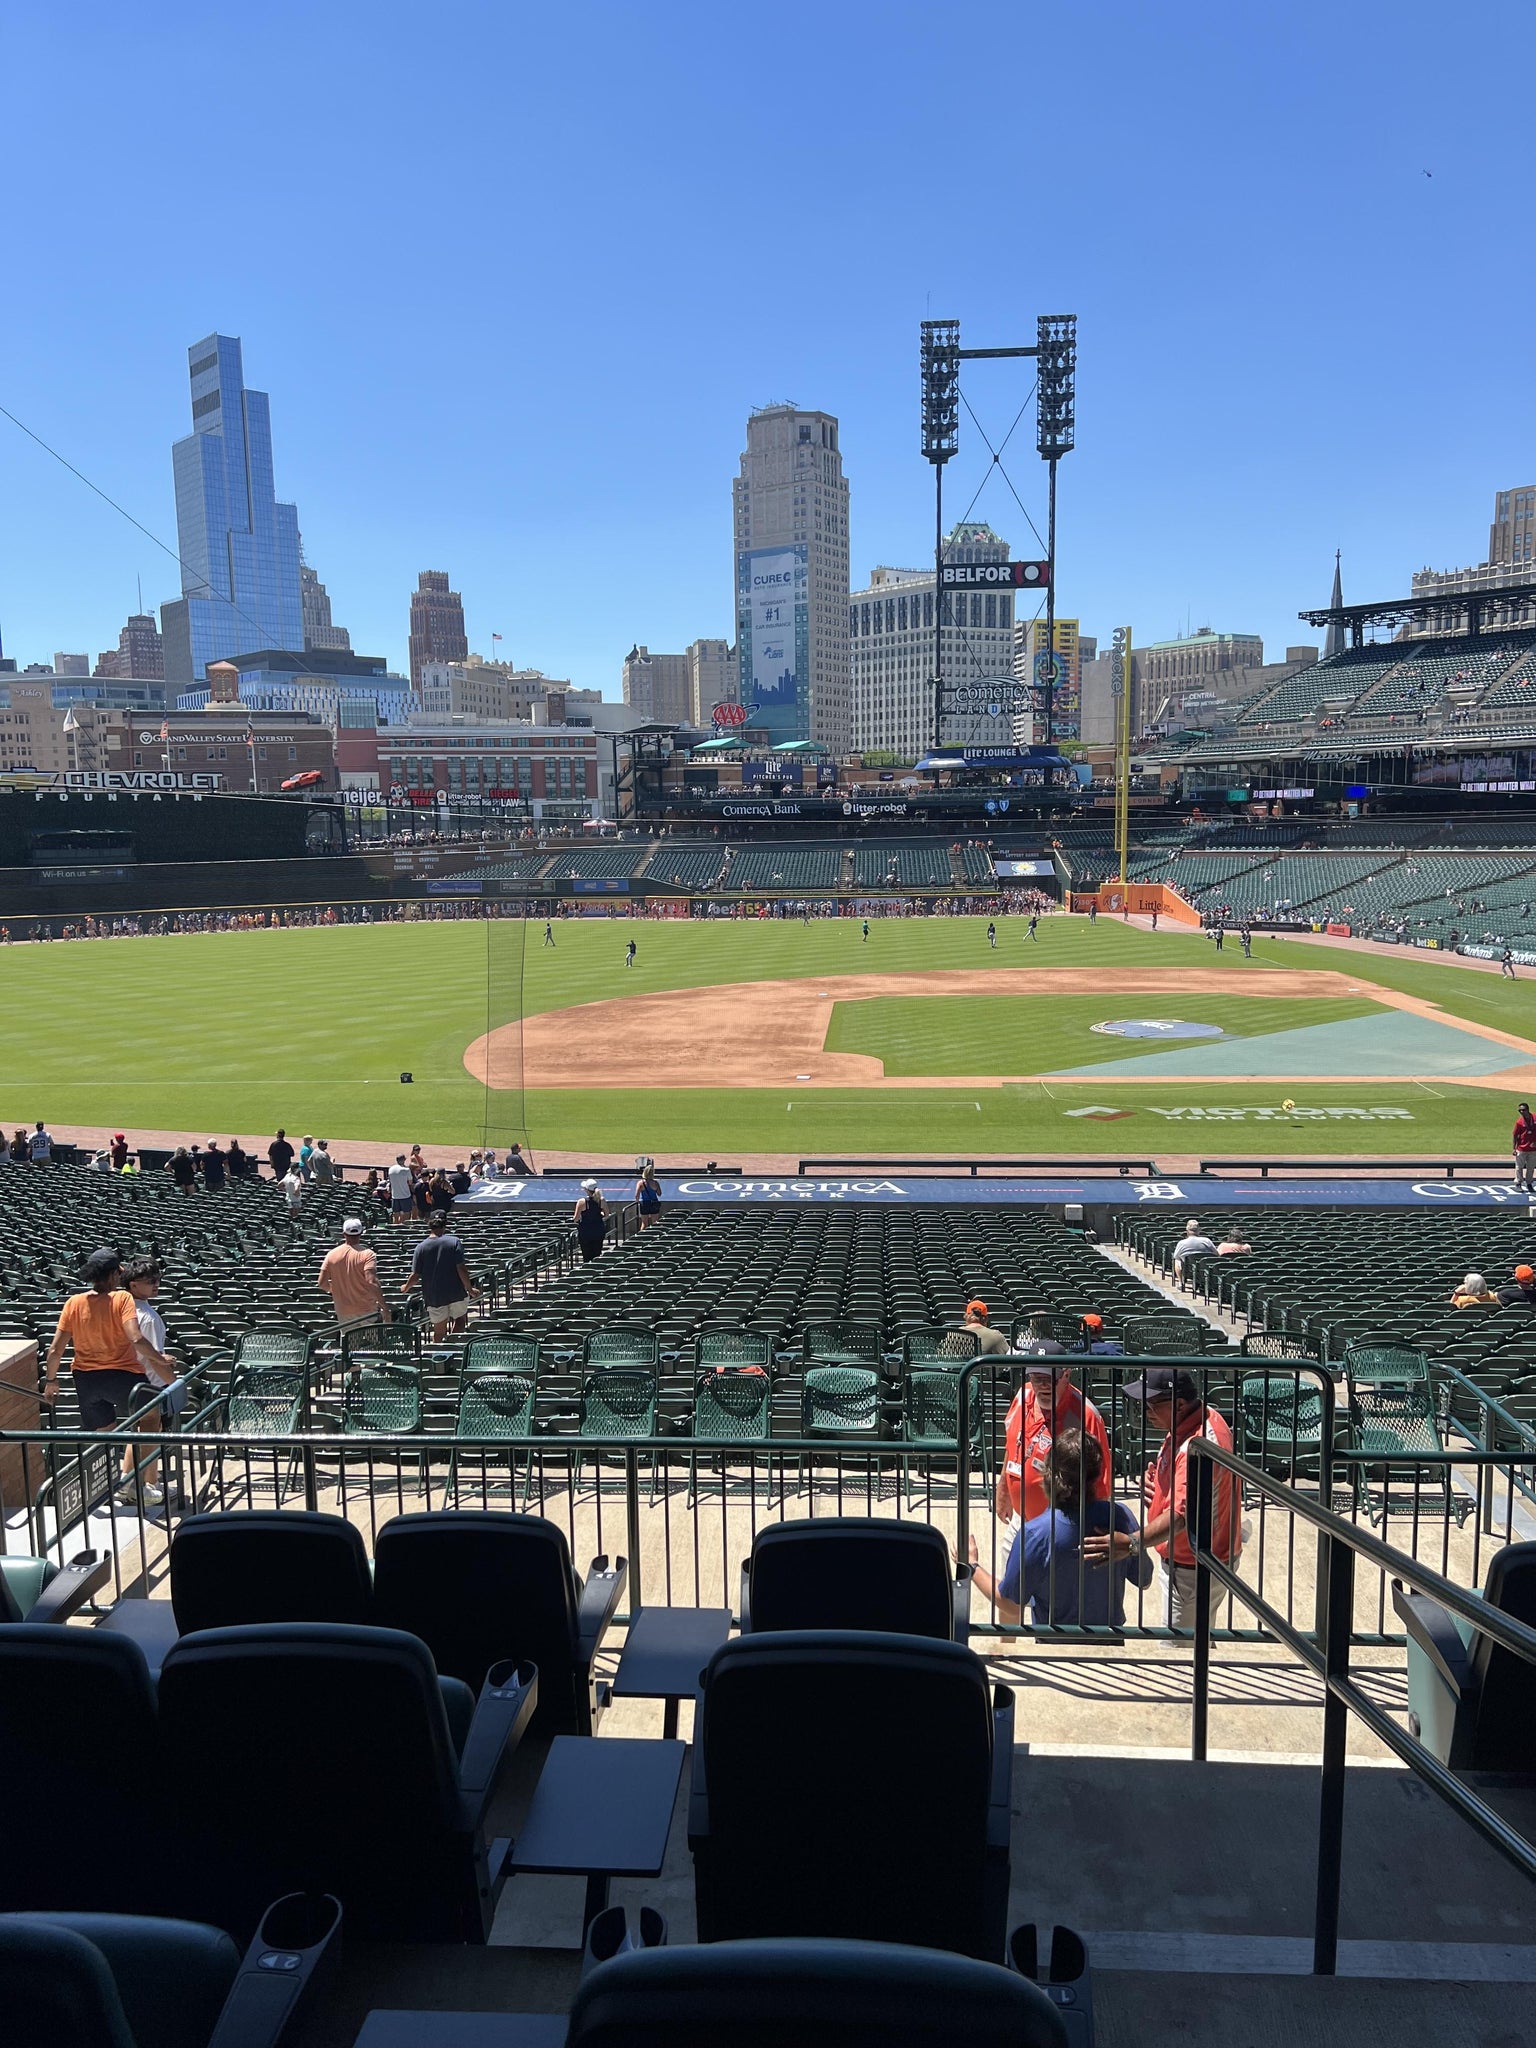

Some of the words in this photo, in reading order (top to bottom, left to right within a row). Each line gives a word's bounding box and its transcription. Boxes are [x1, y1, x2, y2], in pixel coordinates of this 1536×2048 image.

[943, 566, 1011, 583] BELFOR
[765, 607, 780, 621] #1
[766, 621, 792, 629] INSURANCE
[1110, 642, 1126, 697] Rocket
[20, 689, 43, 698] Ashley
[1189, 691, 1217, 700] CENTRAL
[714, 703, 746, 720] AAA
[956, 703, 1034, 716] LANDING
[184, 734, 215, 742] VALLEY
[216, 734, 242, 742] STATE
[963, 748, 982, 760] Lite
[983, 748, 1017, 757] LOUNGE
[1372, 751, 1403, 759] TIGER
[1412, 748, 1437, 758] CLUB
[765, 761, 781, 774] Lite
[66, 772, 223, 789] CHEVROLET
[1497, 781, 1519, 791] MATTER
[1519, 780, 1536, 791] WHAT
[35, 793, 203, 802] FOUNTAIN
[501, 799, 519, 807] LAW
[775, 804, 801, 814] Bank
[538, 841, 547, 849] 42
[1139, 899, 1162, 912] Little
[1416, 937, 1438, 949] bet365
[1144, 1107, 1411, 1116] VICTORS
[33, 1139, 46, 1149] 29
[91, 1446, 116, 1473] CAUTIN
[284, 1955, 299, 1969] 2
